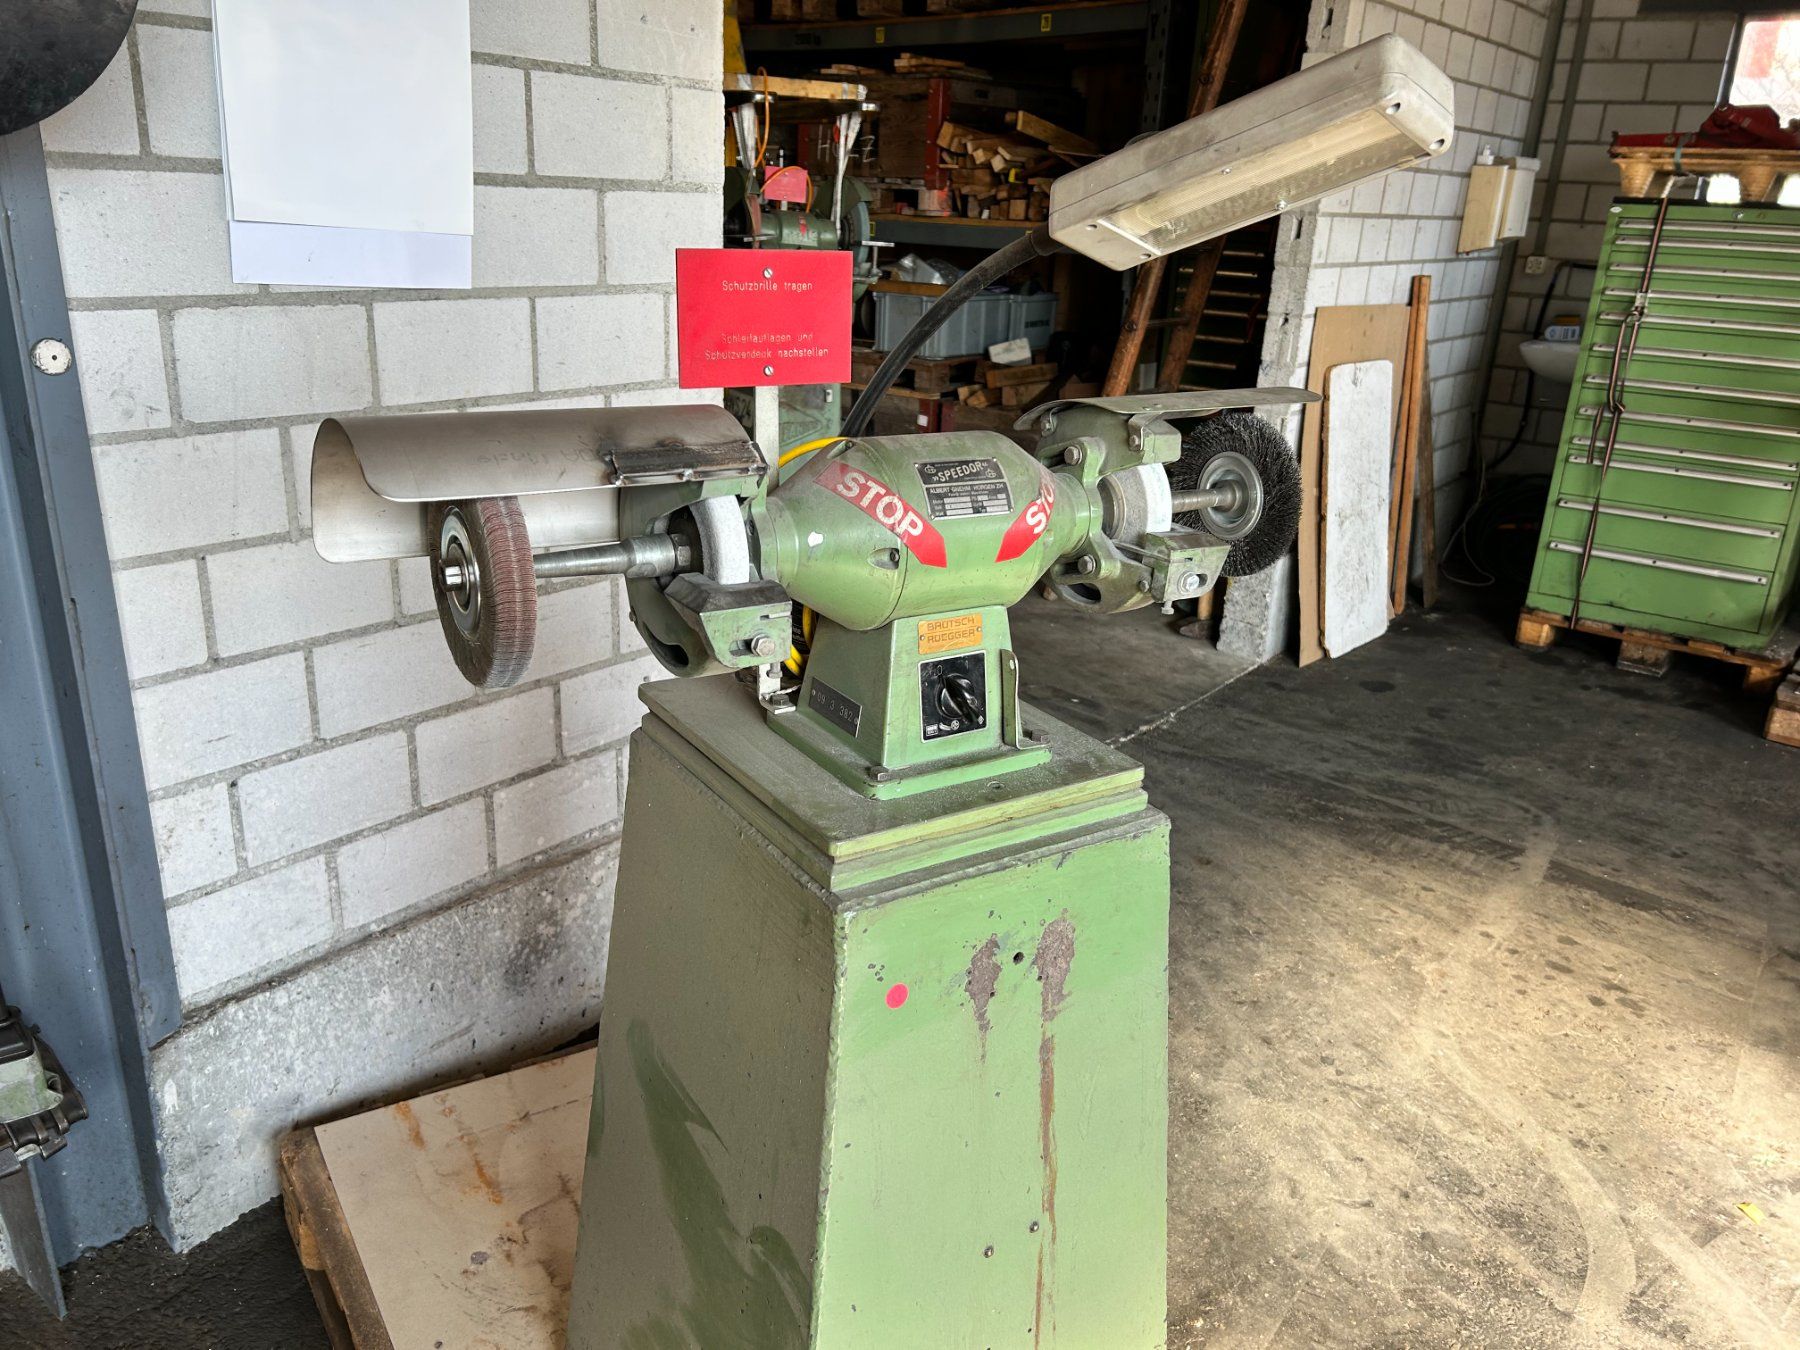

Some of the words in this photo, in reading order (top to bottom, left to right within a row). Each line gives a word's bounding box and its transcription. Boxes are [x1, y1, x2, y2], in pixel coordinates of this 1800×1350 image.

[722, 280, 778, 291] Schutzbrille
[784, 281, 813, 292] tragen
[836, 472, 924, 537] STOP
[839, 705, 853, 721] 382
